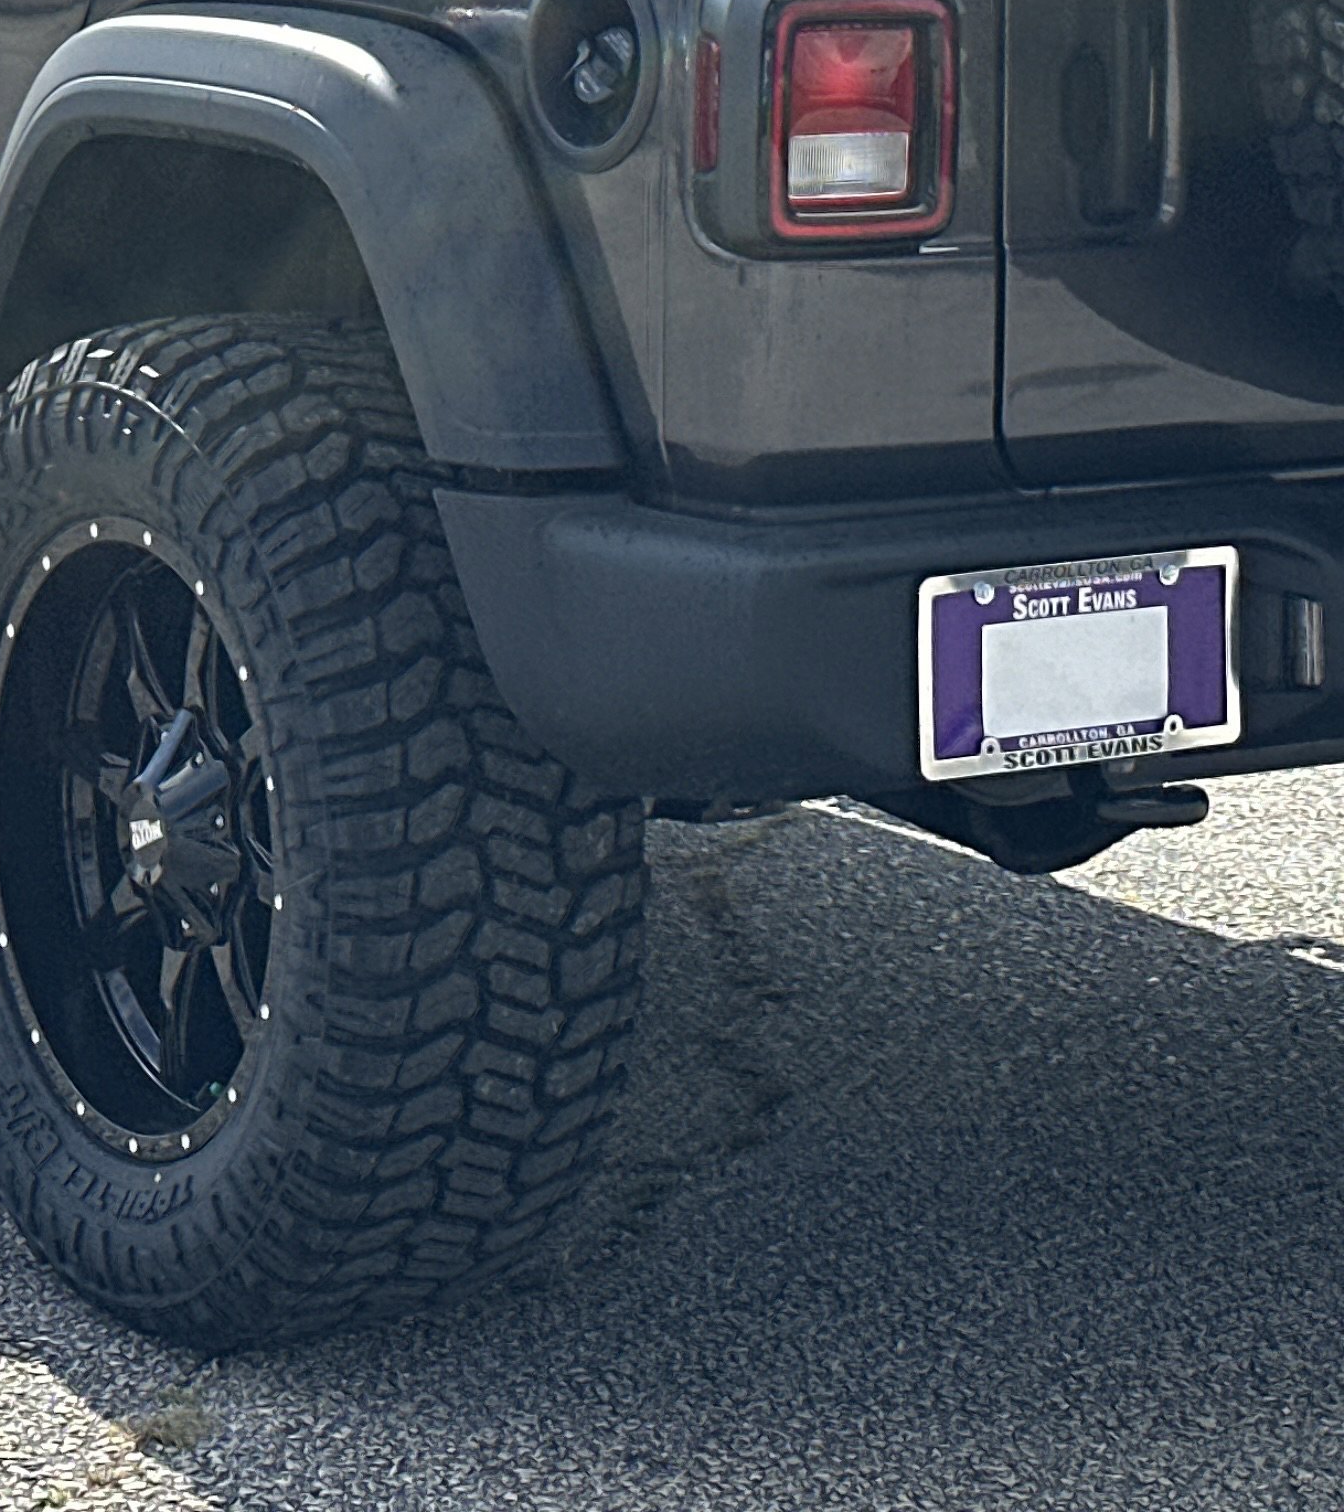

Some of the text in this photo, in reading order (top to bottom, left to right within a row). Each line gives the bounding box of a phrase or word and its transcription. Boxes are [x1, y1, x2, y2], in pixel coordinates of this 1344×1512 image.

[1003, 555, 1154, 584] CARROLLTON GA
[1003, 734, 1164, 769] SCOTT EVANS
